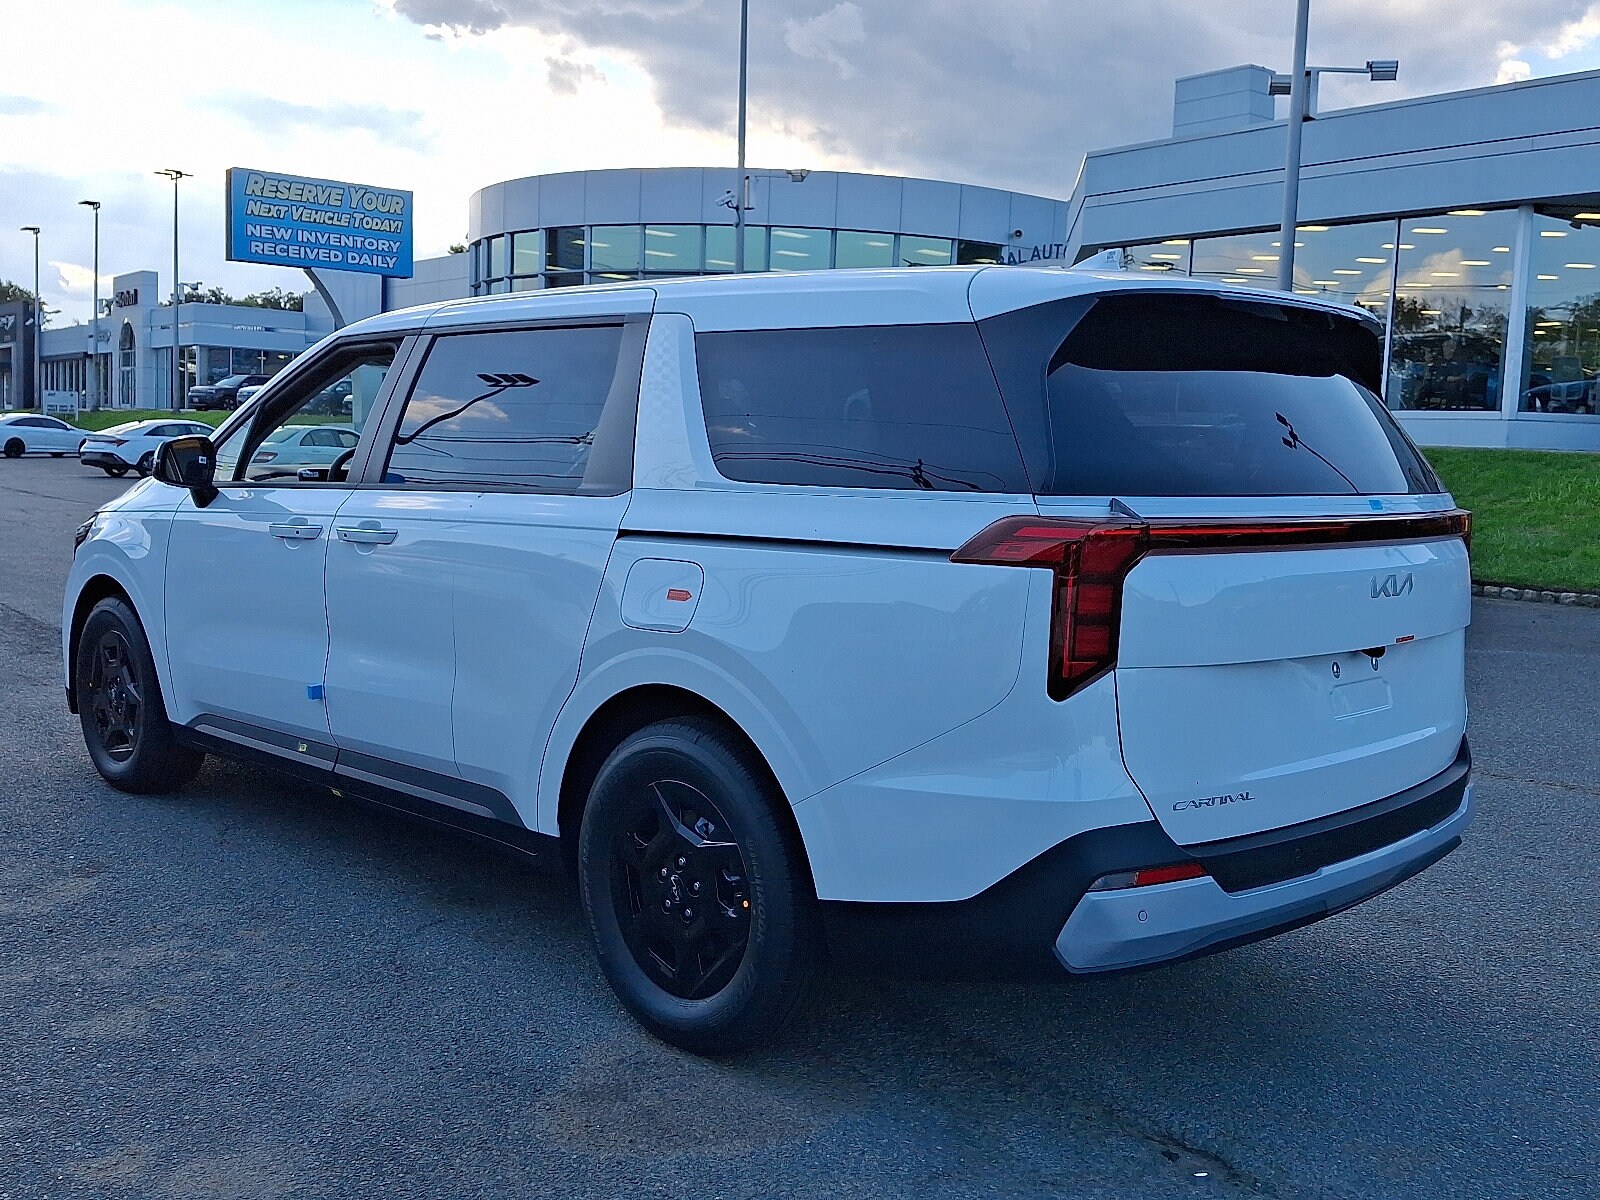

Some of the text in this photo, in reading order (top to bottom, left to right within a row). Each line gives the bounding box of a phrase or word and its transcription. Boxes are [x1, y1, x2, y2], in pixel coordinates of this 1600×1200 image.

[245, 173, 405, 215] RESERVE YOUR
[246, 199, 403, 234] NEXT VEHICLE TODAY!
[246, 223, 402, 253] NEW INVENTORY
[250, 241, 399, 269] RECEIVED DAILY
[1370, 573, 1413, 599] KIA
[1172, 792, 1255, 811] CARNIVAL
